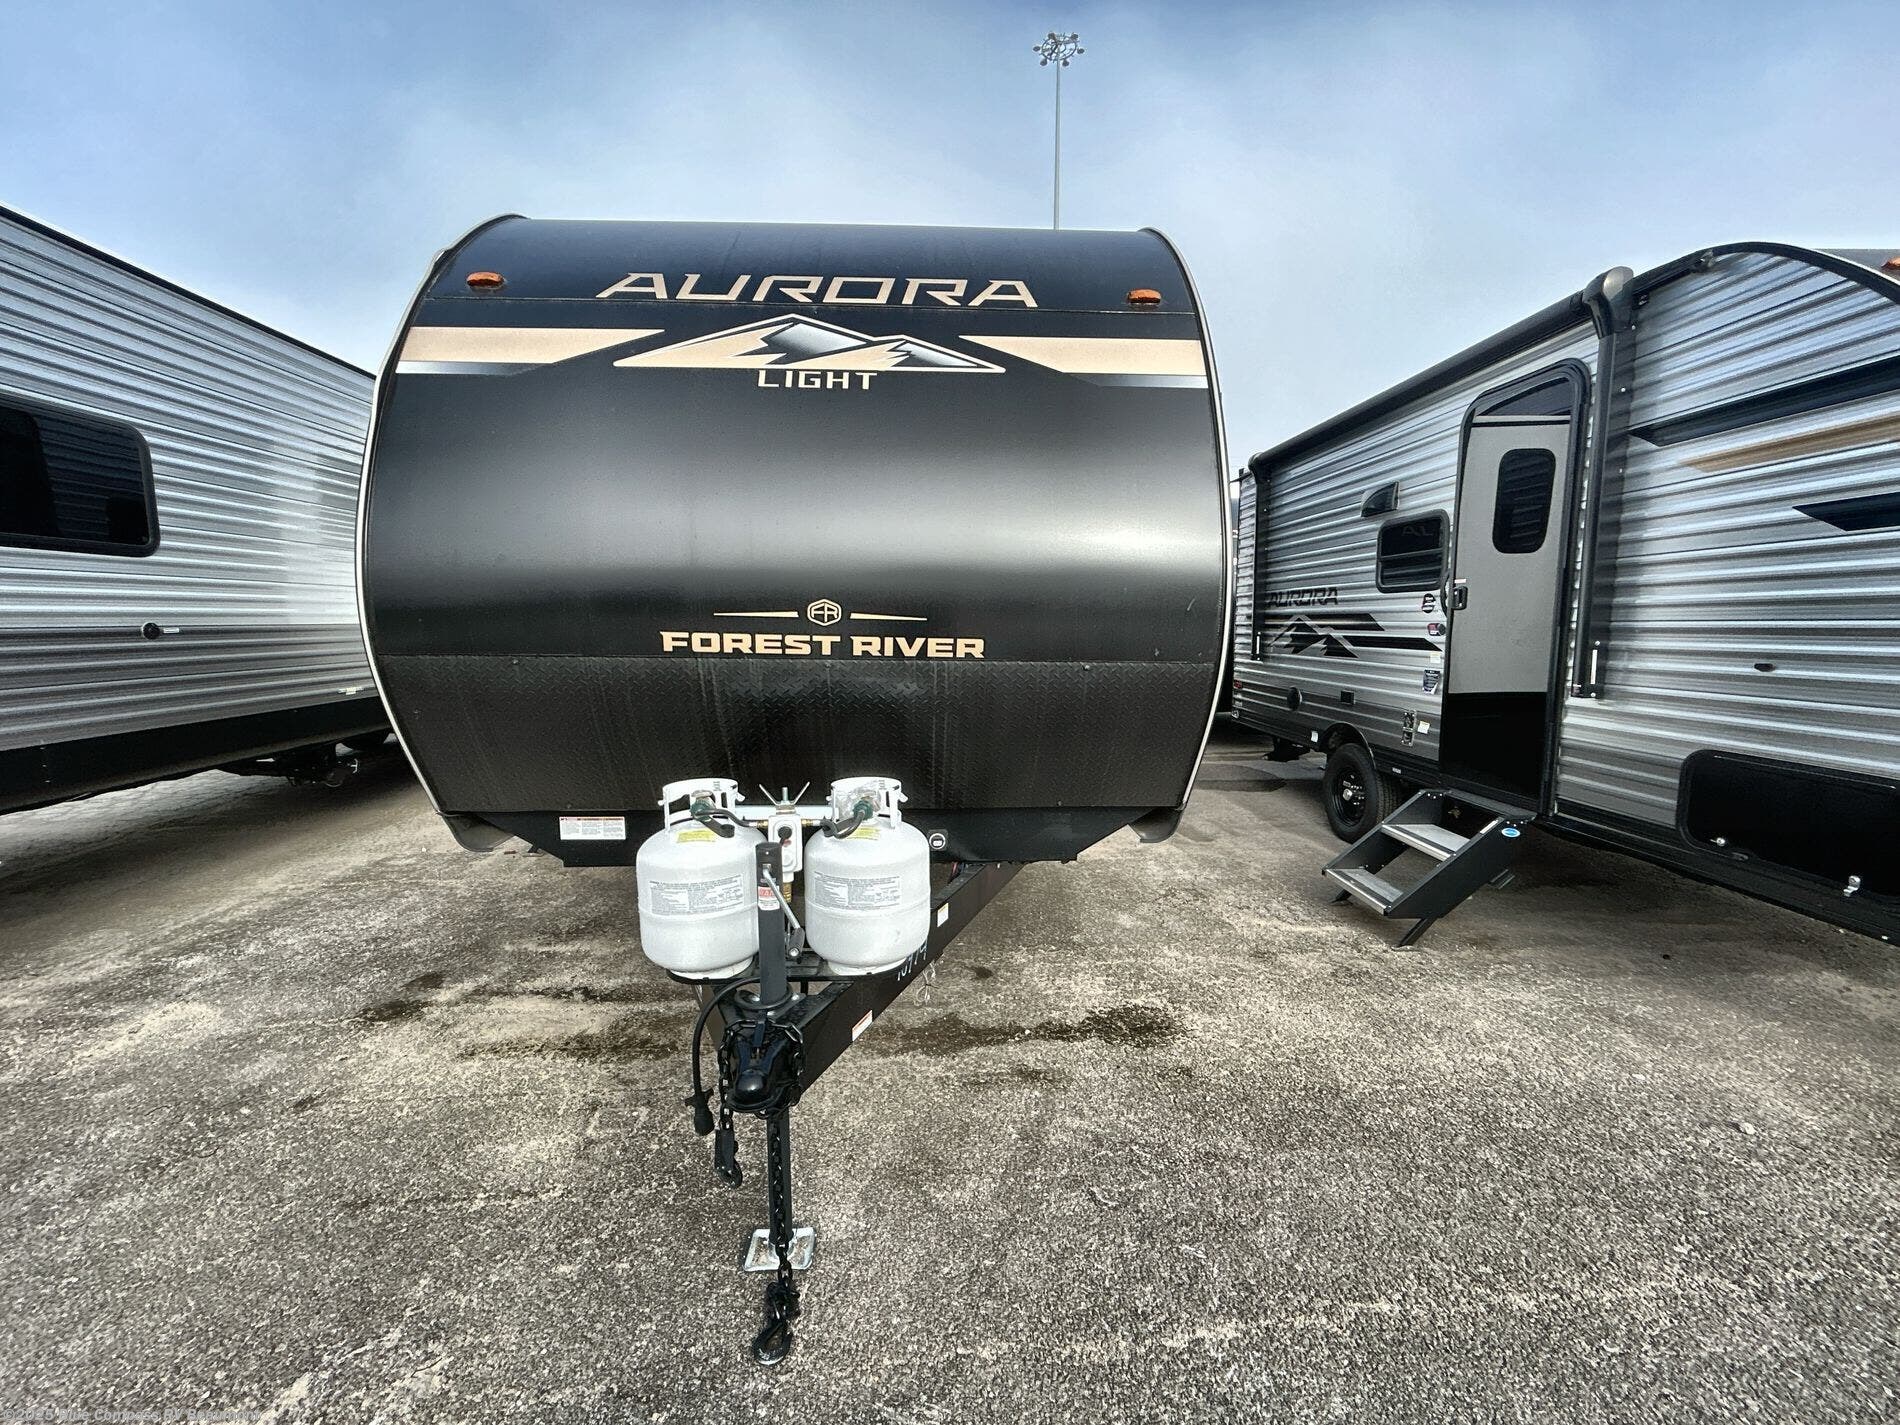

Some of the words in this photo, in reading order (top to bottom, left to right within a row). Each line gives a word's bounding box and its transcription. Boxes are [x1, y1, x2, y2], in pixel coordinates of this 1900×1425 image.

[595, 272, 1038, 308] AURORA
[757, 369, 878, 390] LIGHT
[1266, 586, 1339, 608] AURORA
[659, 630, 841, 656] FOREST
[849, 635, 985, 659] RIVER
